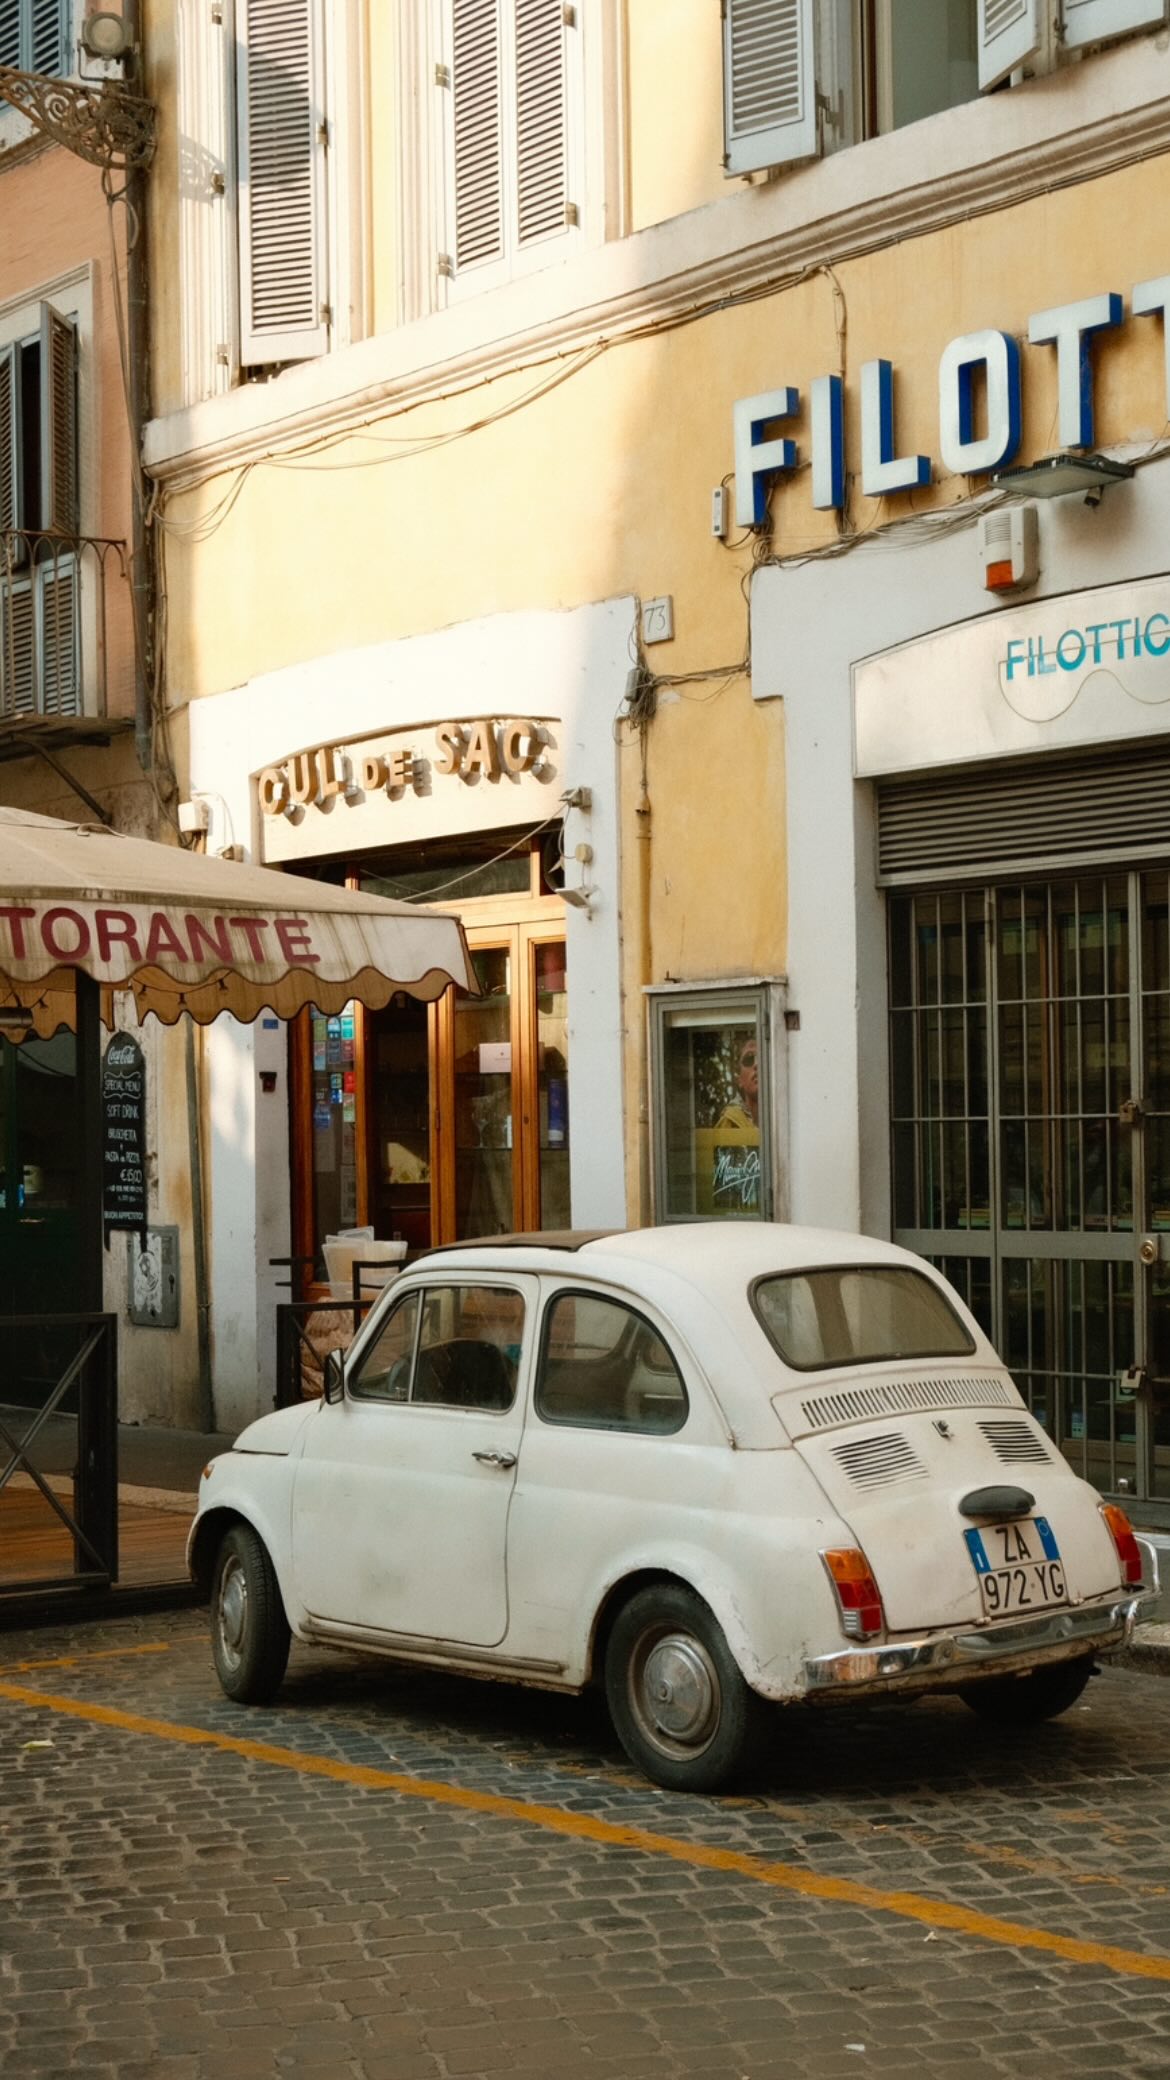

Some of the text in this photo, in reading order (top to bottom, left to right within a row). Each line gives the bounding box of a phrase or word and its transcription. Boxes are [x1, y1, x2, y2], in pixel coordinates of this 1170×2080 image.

[644, 605, 665, 633] 73
[1006, 613, 1170, 680] FILOTTIC
[258, 720, 539, 815] CUL DE SAC
[0, 906, 321, 964] TORANTE
[996, 1525, 1031, 1562] ZA
